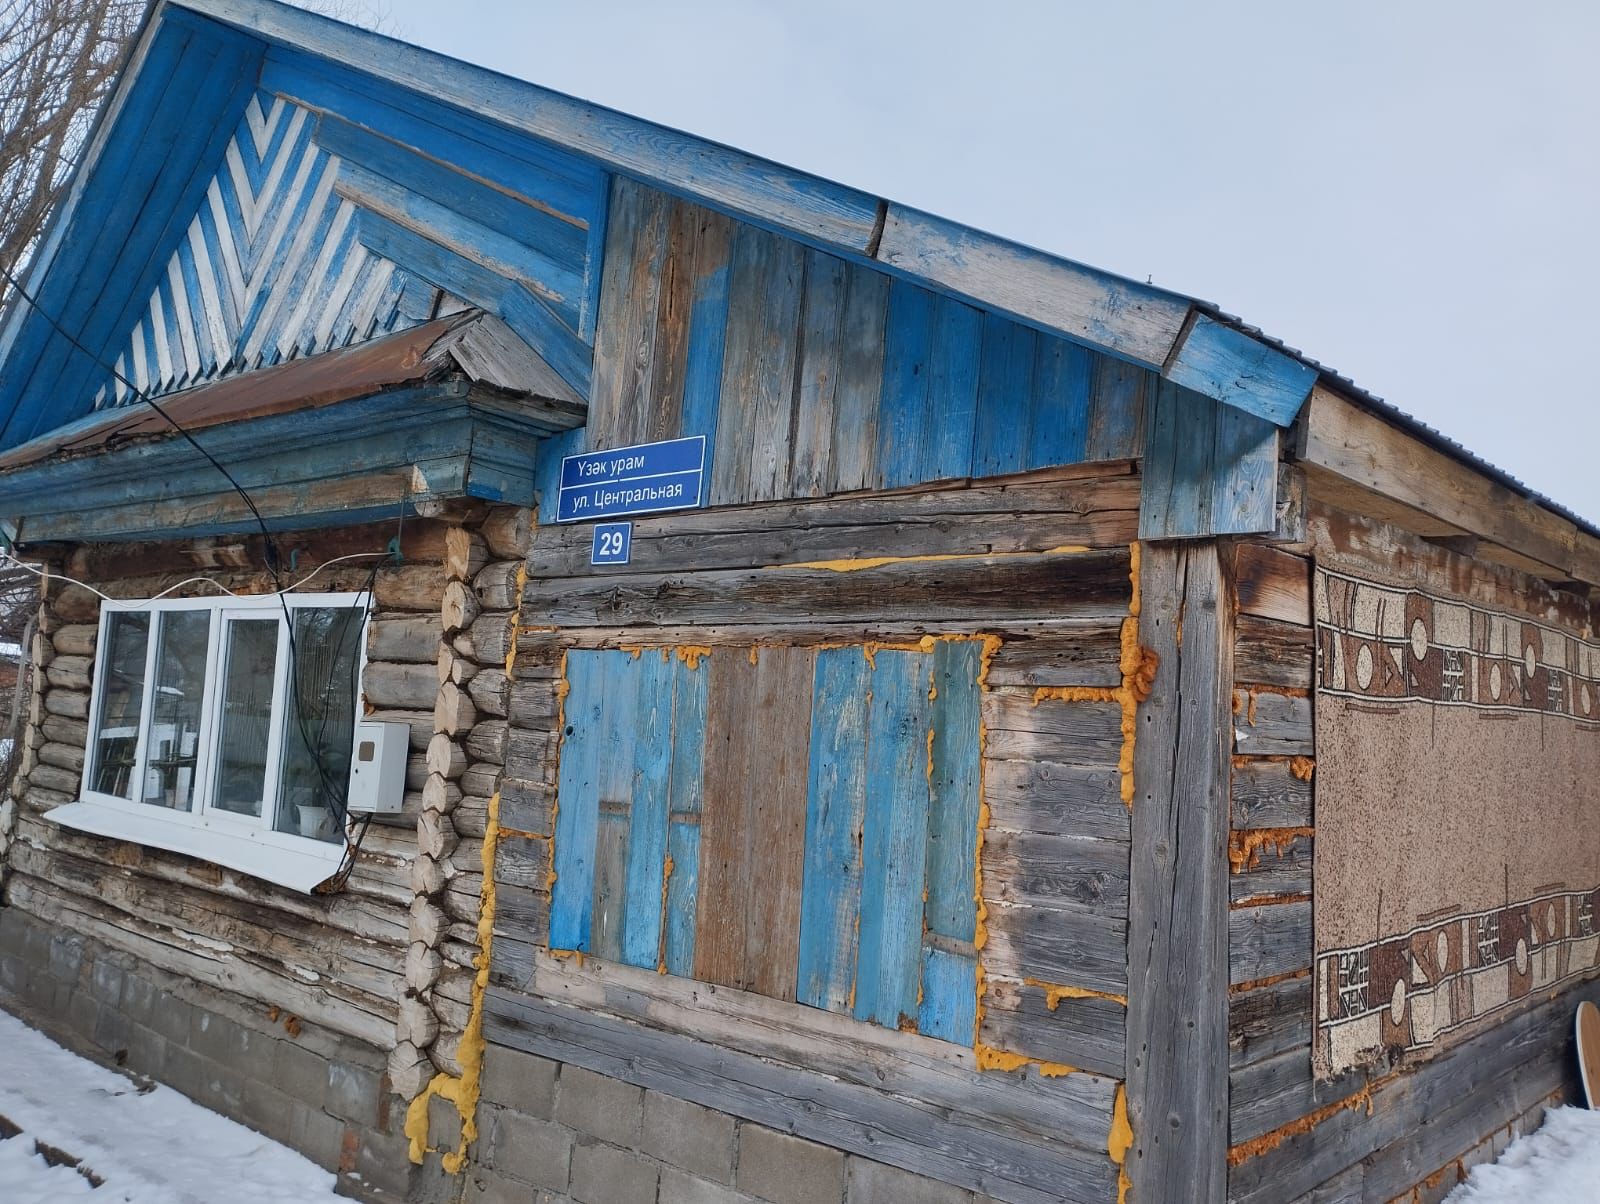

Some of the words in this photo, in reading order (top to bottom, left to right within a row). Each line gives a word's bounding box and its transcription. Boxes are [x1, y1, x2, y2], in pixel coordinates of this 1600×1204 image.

[609, 455, 645, 477] урам
[572, 496, 590, 512] ул.
[594, 483, 683, 509] Центральная
[599, 531, 623, 556] 29
